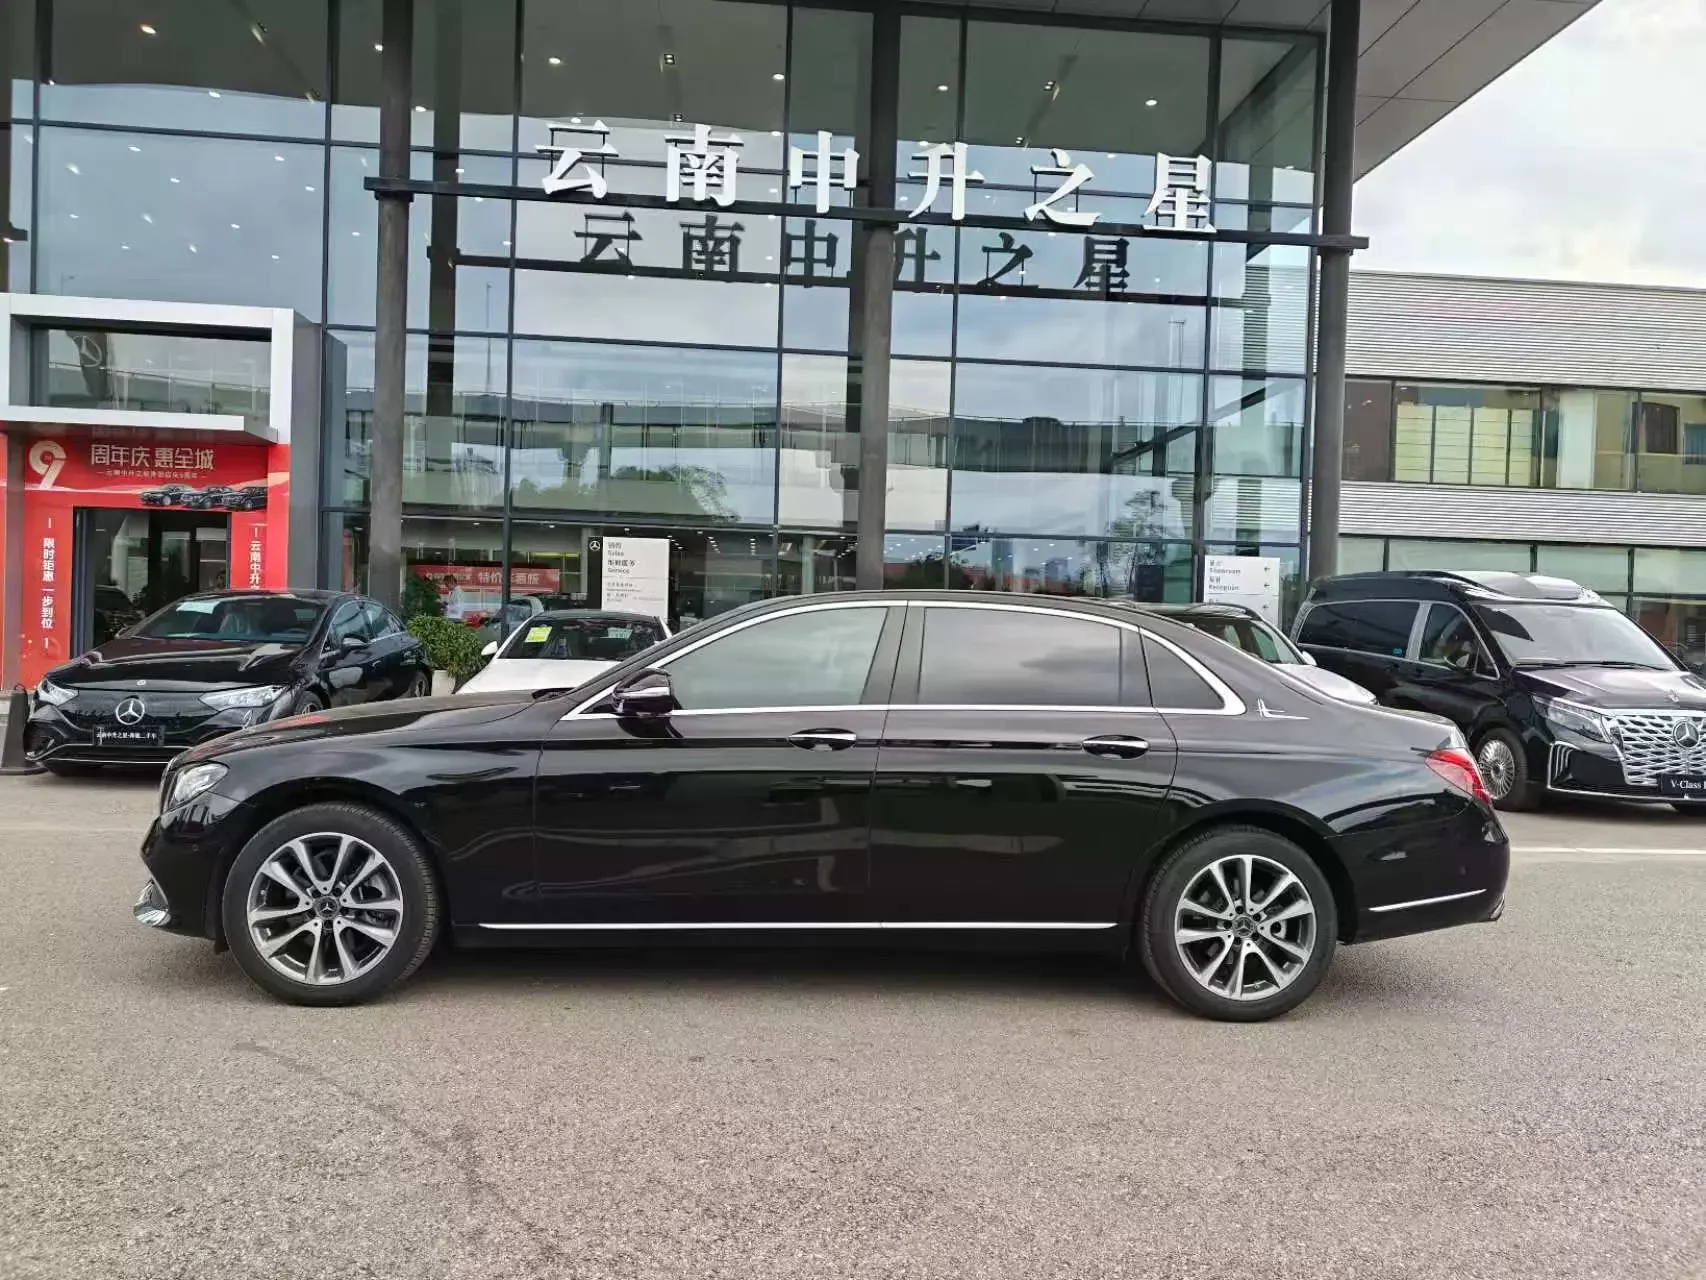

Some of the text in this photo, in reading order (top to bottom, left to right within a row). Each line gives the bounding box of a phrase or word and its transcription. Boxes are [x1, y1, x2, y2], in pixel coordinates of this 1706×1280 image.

[535, 119, 1217, 234] 云南中升之星
[29, 440, 214, 490] 9 周年庆 惠全城
[40, 588, 55, 629] 一步到位
[1670, 779, 1702, 789] V-Class
